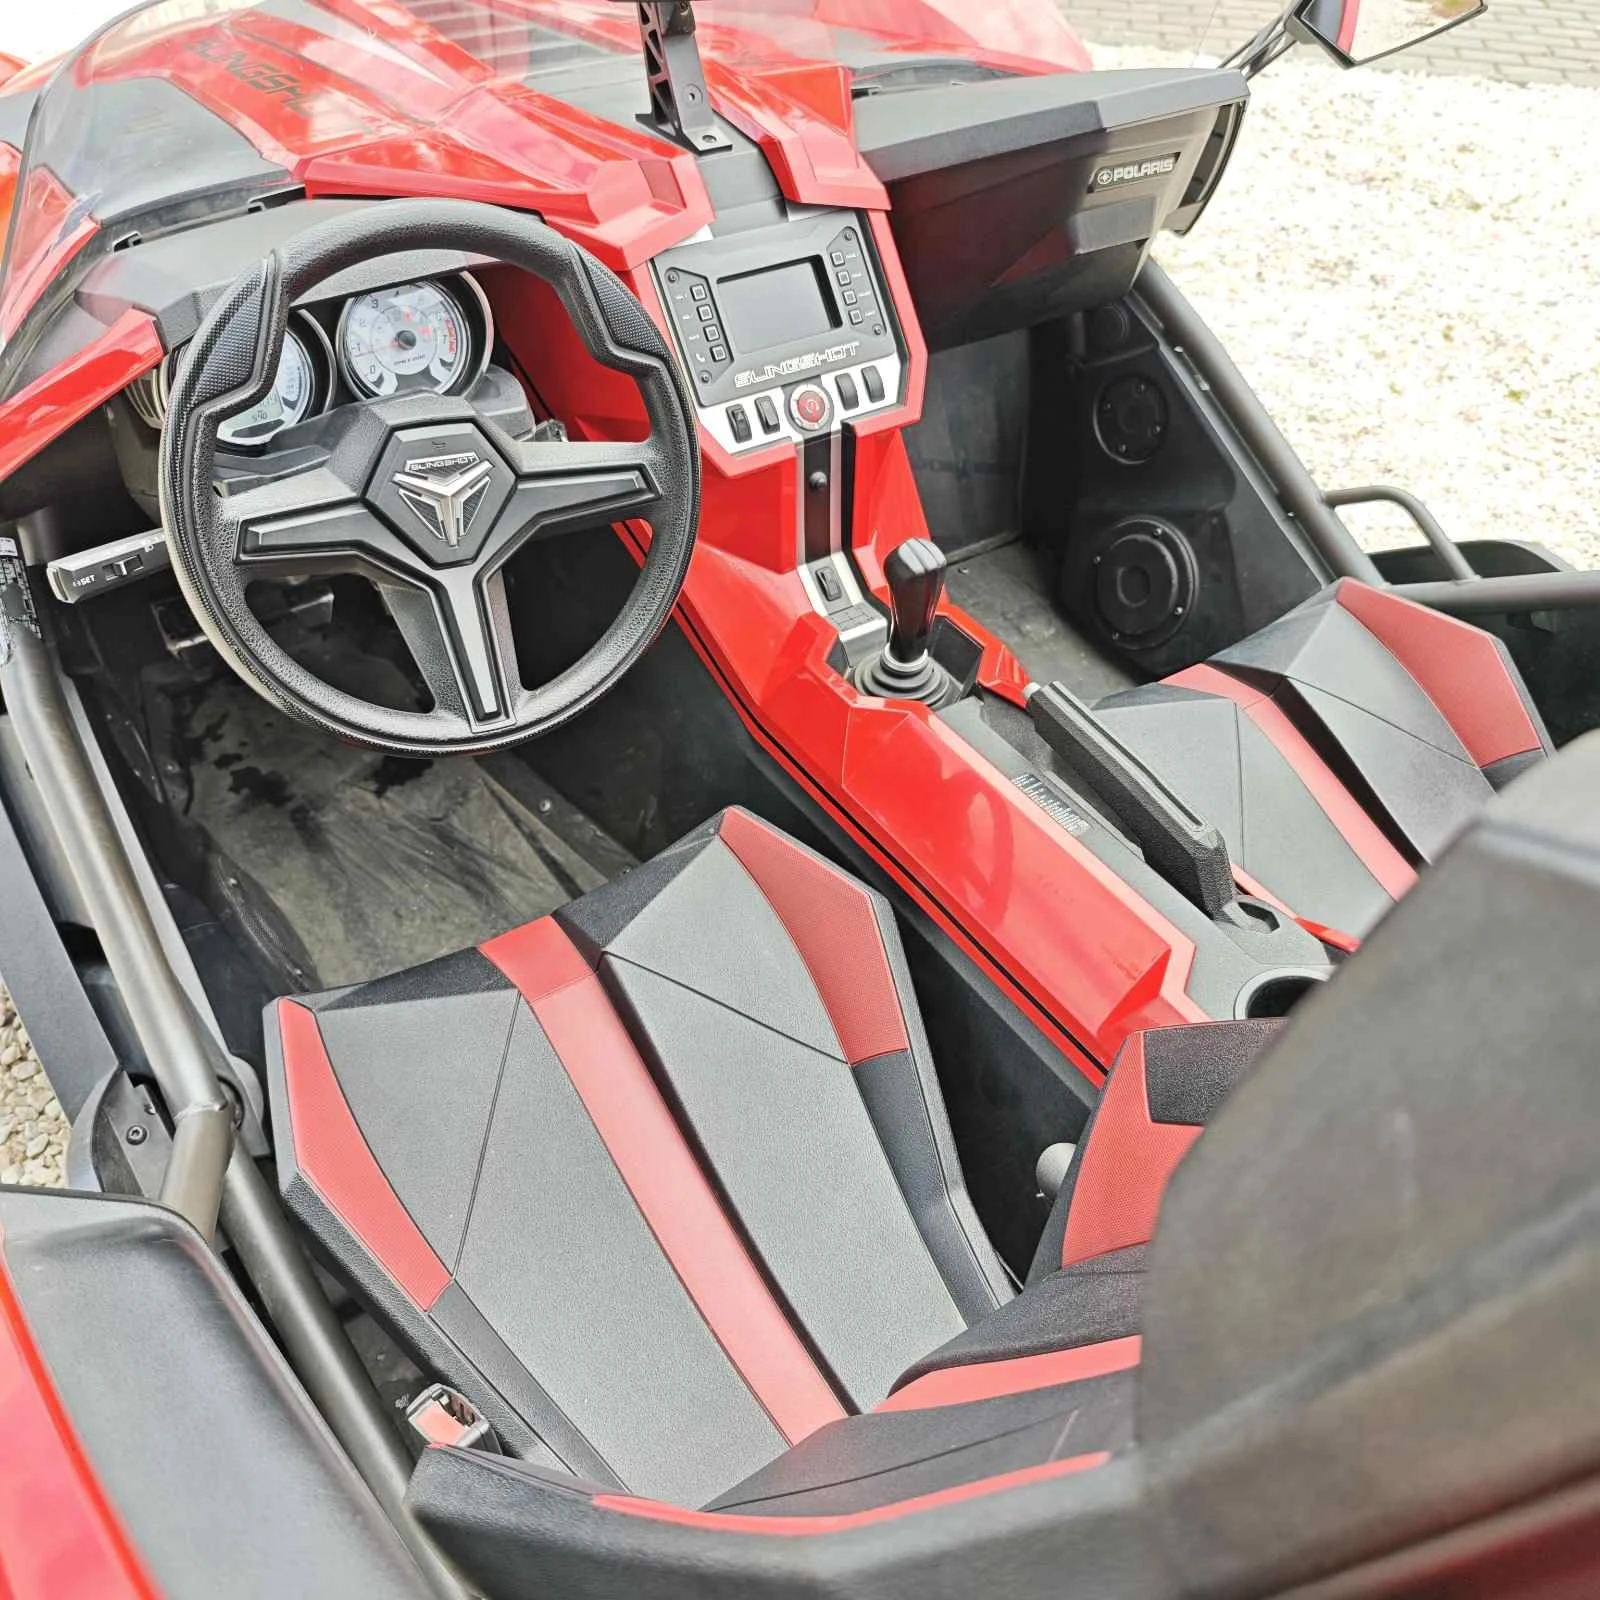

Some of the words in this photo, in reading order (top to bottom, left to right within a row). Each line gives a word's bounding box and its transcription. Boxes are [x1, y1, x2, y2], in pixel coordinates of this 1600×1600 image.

[1113, 158, 1174, 182] POLARIS
[733, 341, 860, 388] SLINGSHOT
[410, 455, 476, 471] SLINGSHOT
